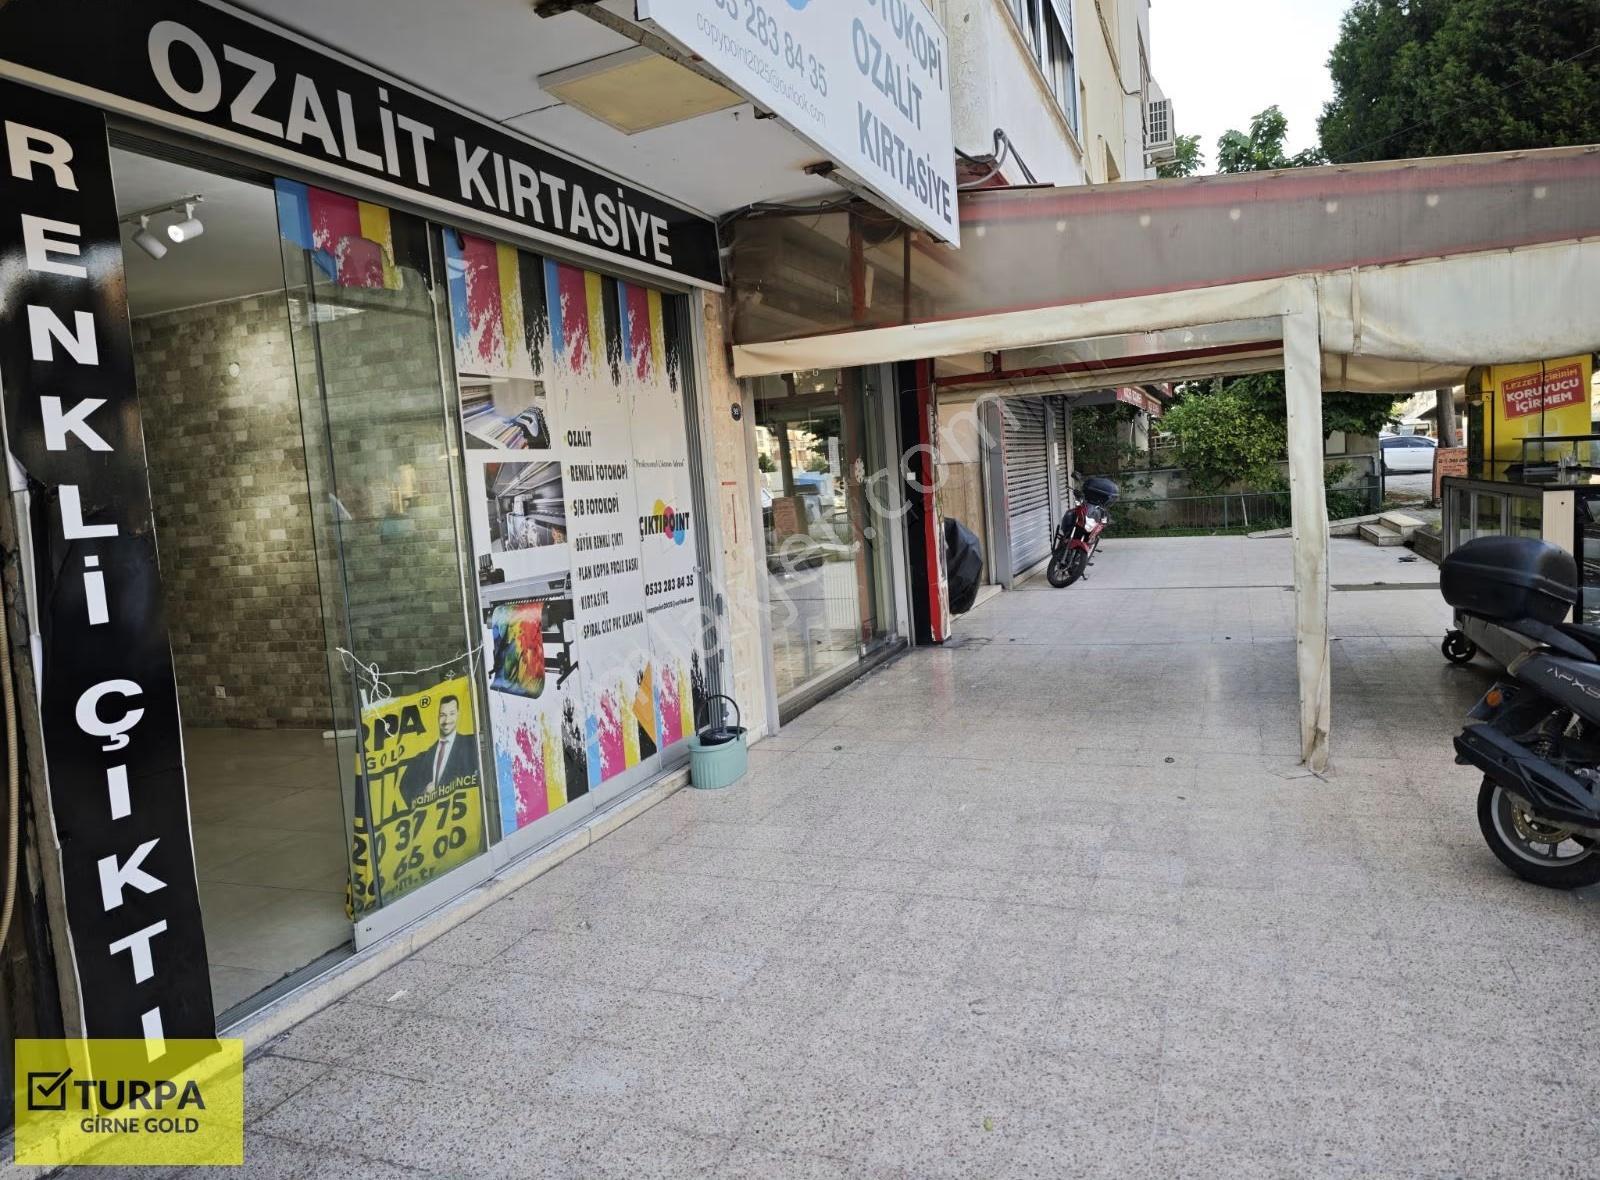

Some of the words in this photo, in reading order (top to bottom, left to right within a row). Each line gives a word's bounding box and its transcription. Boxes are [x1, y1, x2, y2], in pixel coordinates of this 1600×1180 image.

[784, 31, 805, 78] 84
[808, 54, 827, 97] 35
[852, 17, 922, 131] OZALİT
[148, 20, 435, 187] OZALİT
[454, 136, 673, 265] KIRTASİYE
[857, 100, 952, 225] KIRTASİYE
[1506, 378, 1580, 402] KORUYUCU
[567, 425, 592, 448] OZALİT
[573, 499, 585, 518] S/B
[645, 581, 662, 596] 0533
[663, 578, 676, 592] 283
[677, 576, 685, 589] 84
[686, 574, 694, 587] 35
[436, 792, 467, 830] 75
[433, 826, 467, 859] 00
